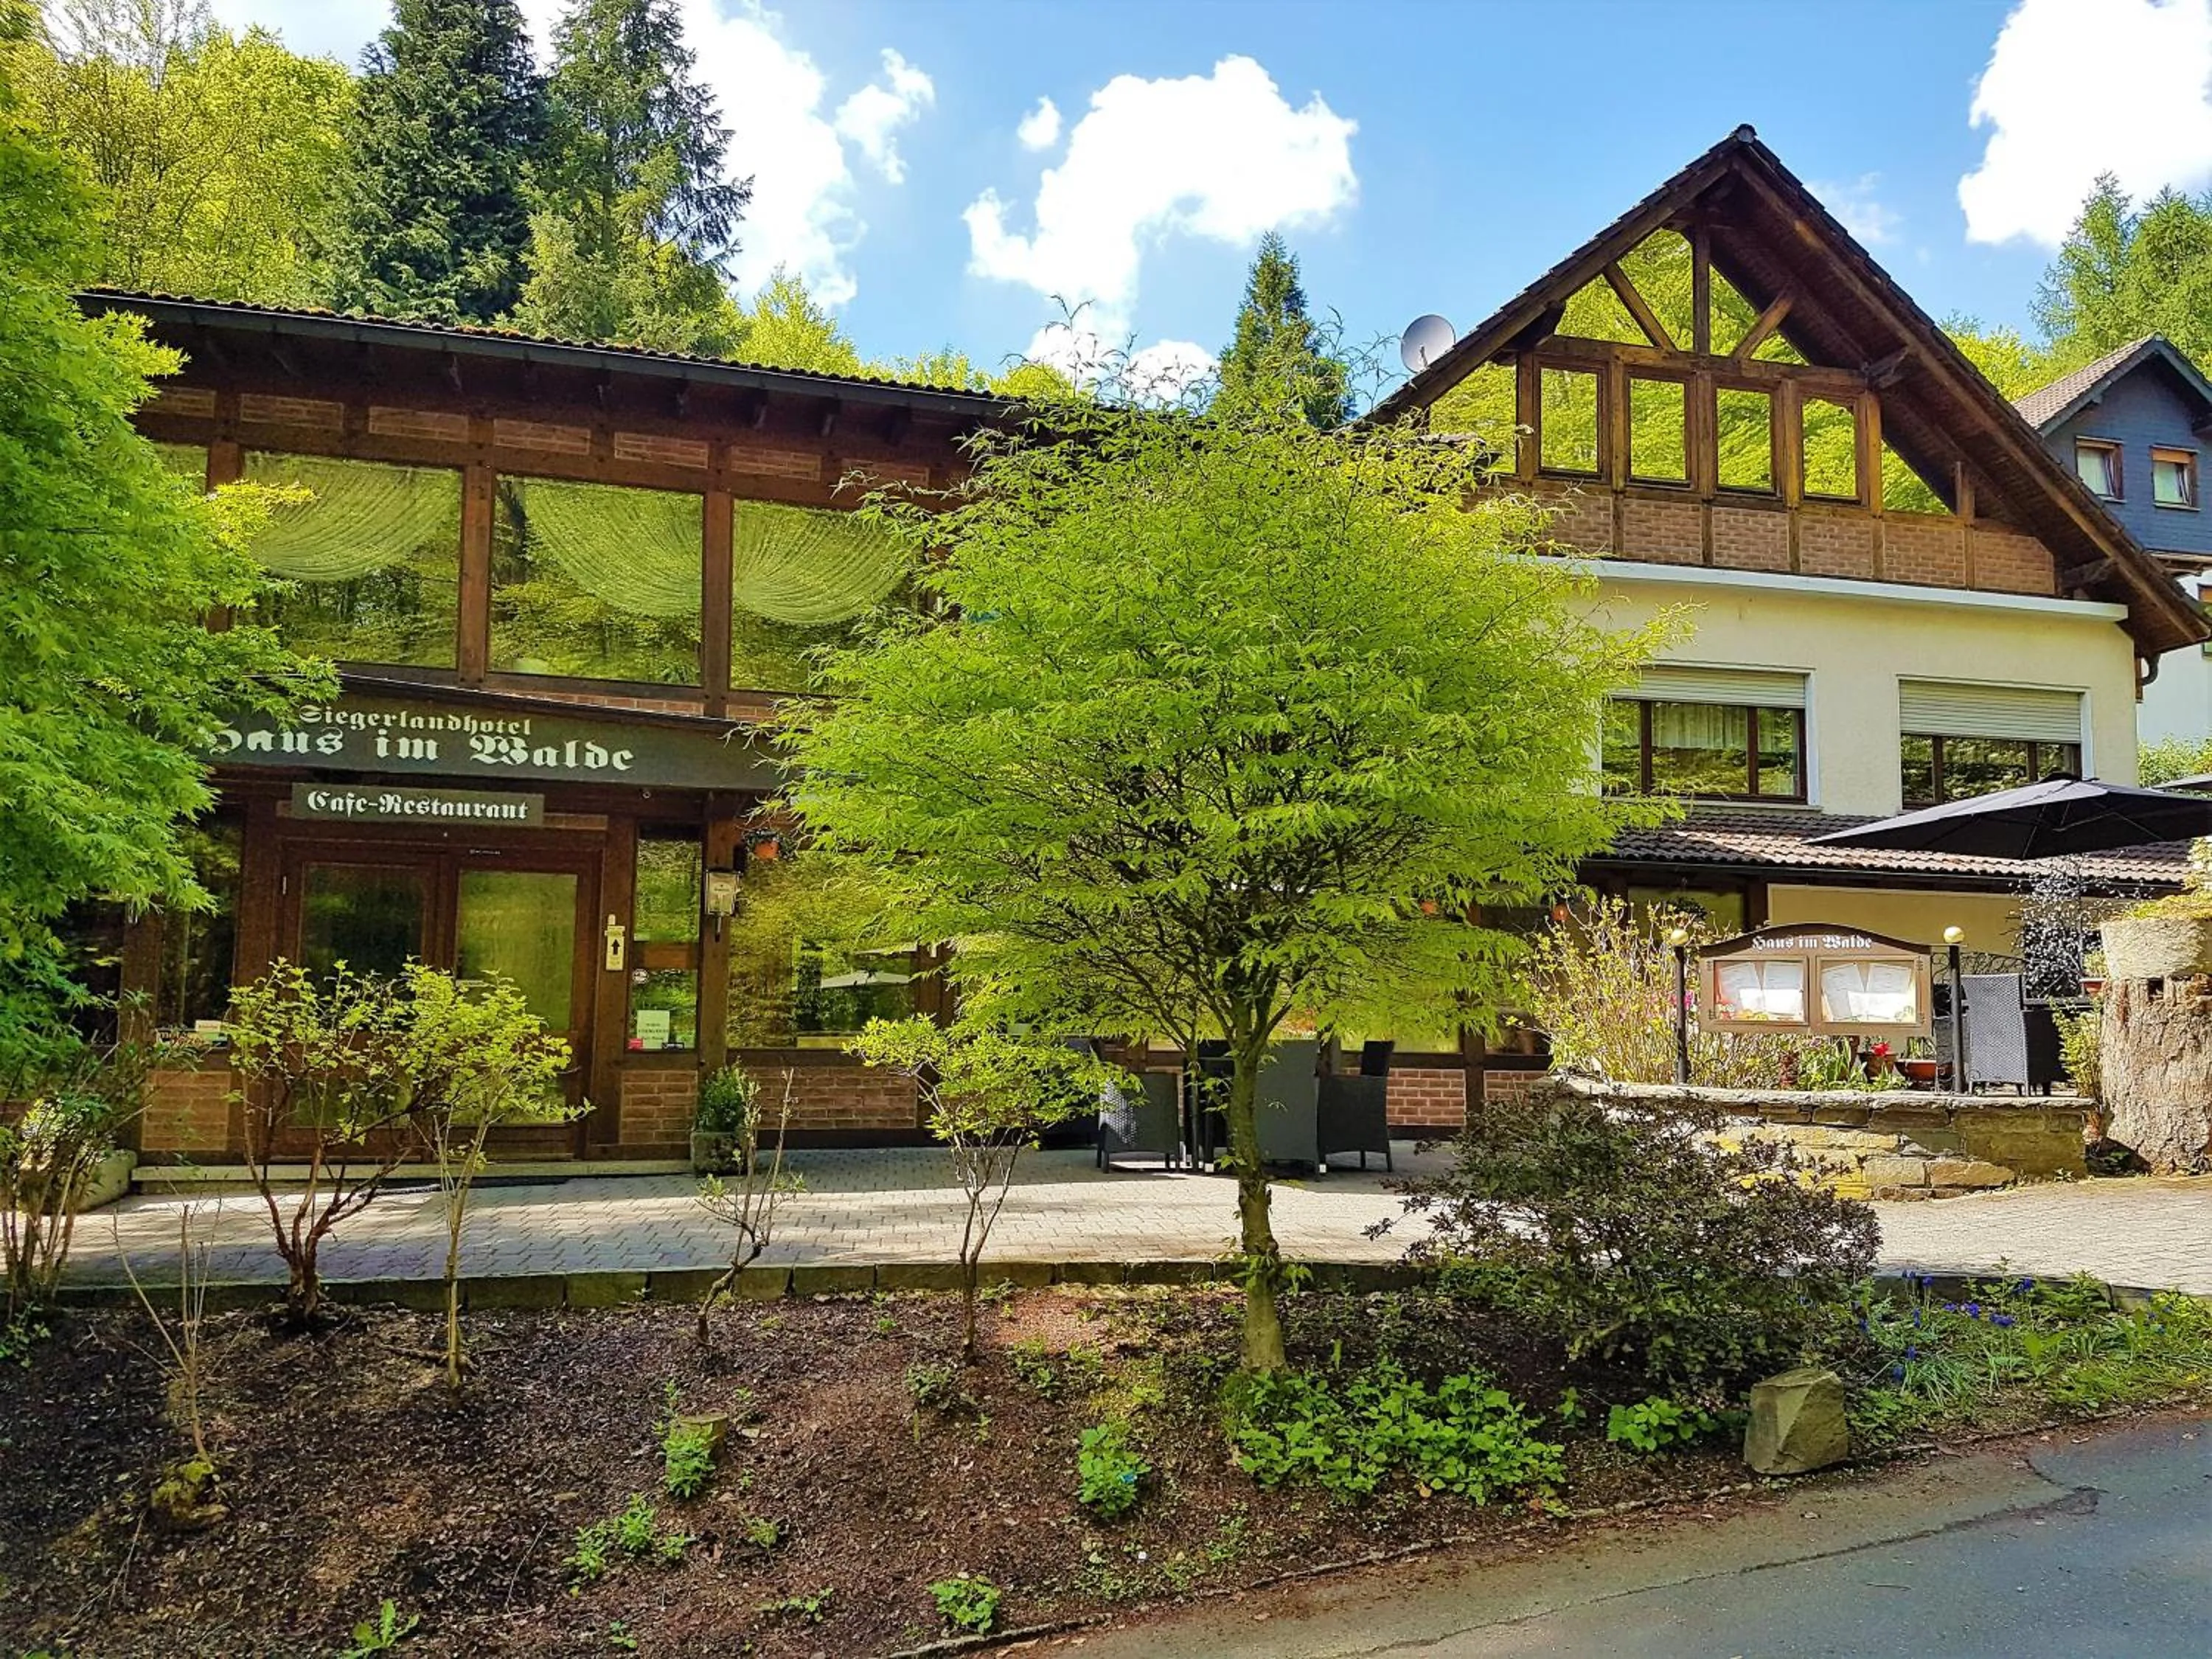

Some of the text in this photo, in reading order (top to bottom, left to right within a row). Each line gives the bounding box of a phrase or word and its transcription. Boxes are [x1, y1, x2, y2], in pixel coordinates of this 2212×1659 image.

[299, 704, 531, 736] Siegerlandhotel
[375, 728, 439, 760] im
[469, 734, 633, 771] Walde
[307, 790, 528, 819] Cafe-Restaurant
[1752, 934, 1872, 950] Haus im Walde
